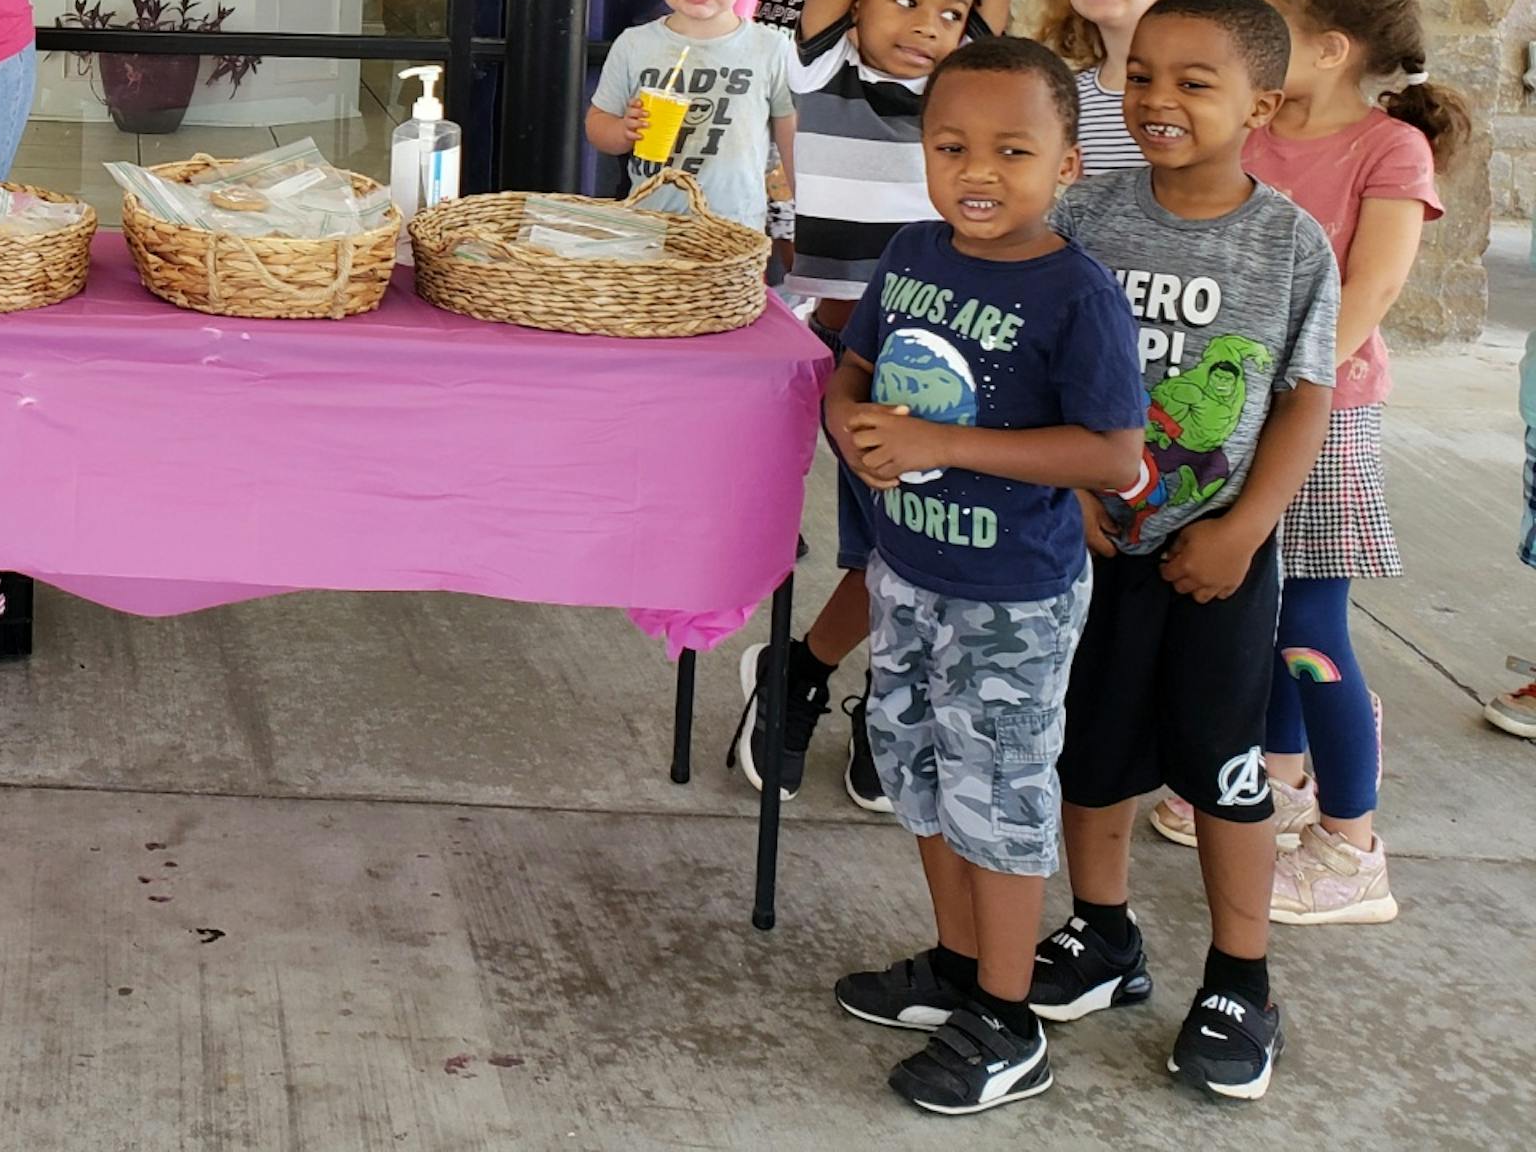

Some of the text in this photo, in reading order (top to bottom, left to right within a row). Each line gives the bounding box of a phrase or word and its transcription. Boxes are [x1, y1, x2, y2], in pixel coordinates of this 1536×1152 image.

[881, 272, 1026, 352] DINOS ARE
[1116, 269, 1222, 326] ERO
[883, 487, 998, 549] WORLD
[1200, 994, 1246, 1023] AIR
